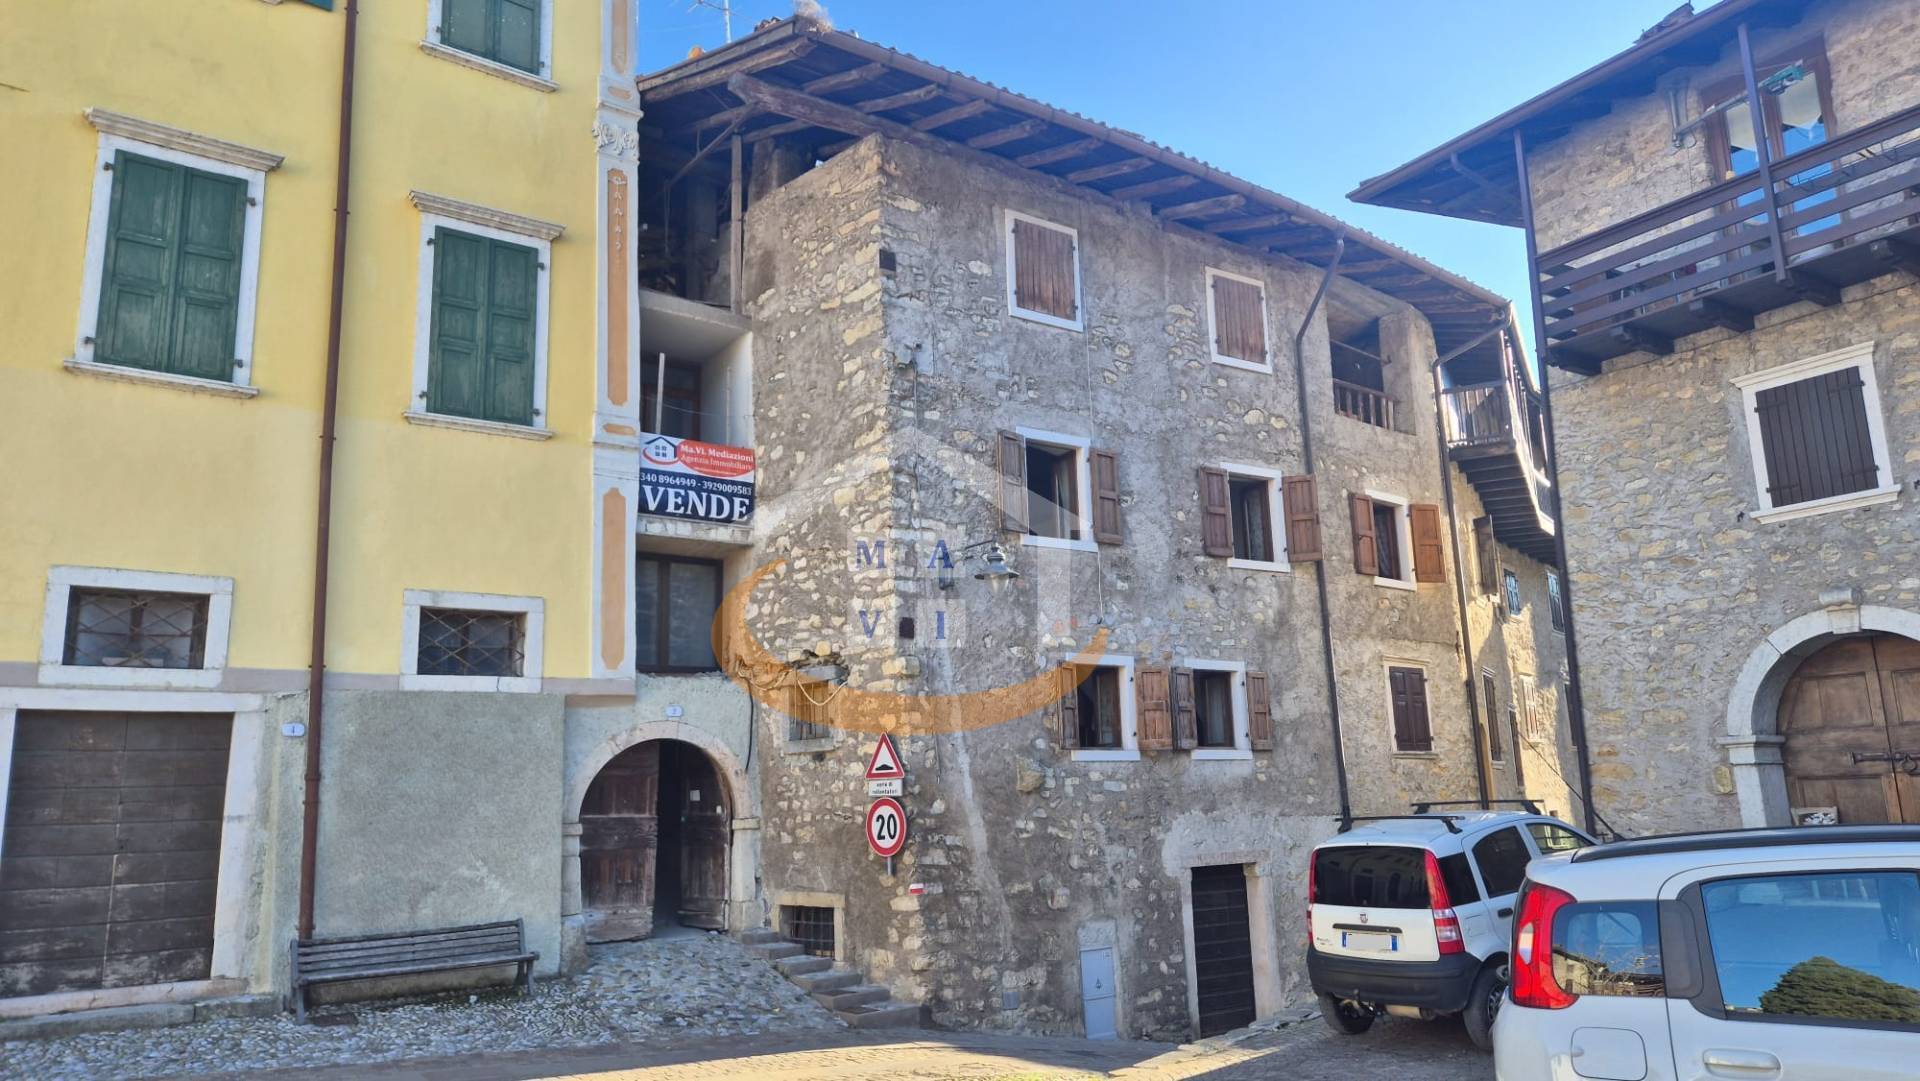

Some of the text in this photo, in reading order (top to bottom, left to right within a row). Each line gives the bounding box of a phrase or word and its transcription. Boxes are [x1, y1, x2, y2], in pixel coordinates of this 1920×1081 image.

[708, 448, 754, 463] Mediazioni
[640, 472, 657, 482] 340
[659, 474, 696, 488] 8964949
[703, 480, 752, 496] 3929009583
[642, 485, 750, 521] VENDE
[875, 813, 898, 841] 20
